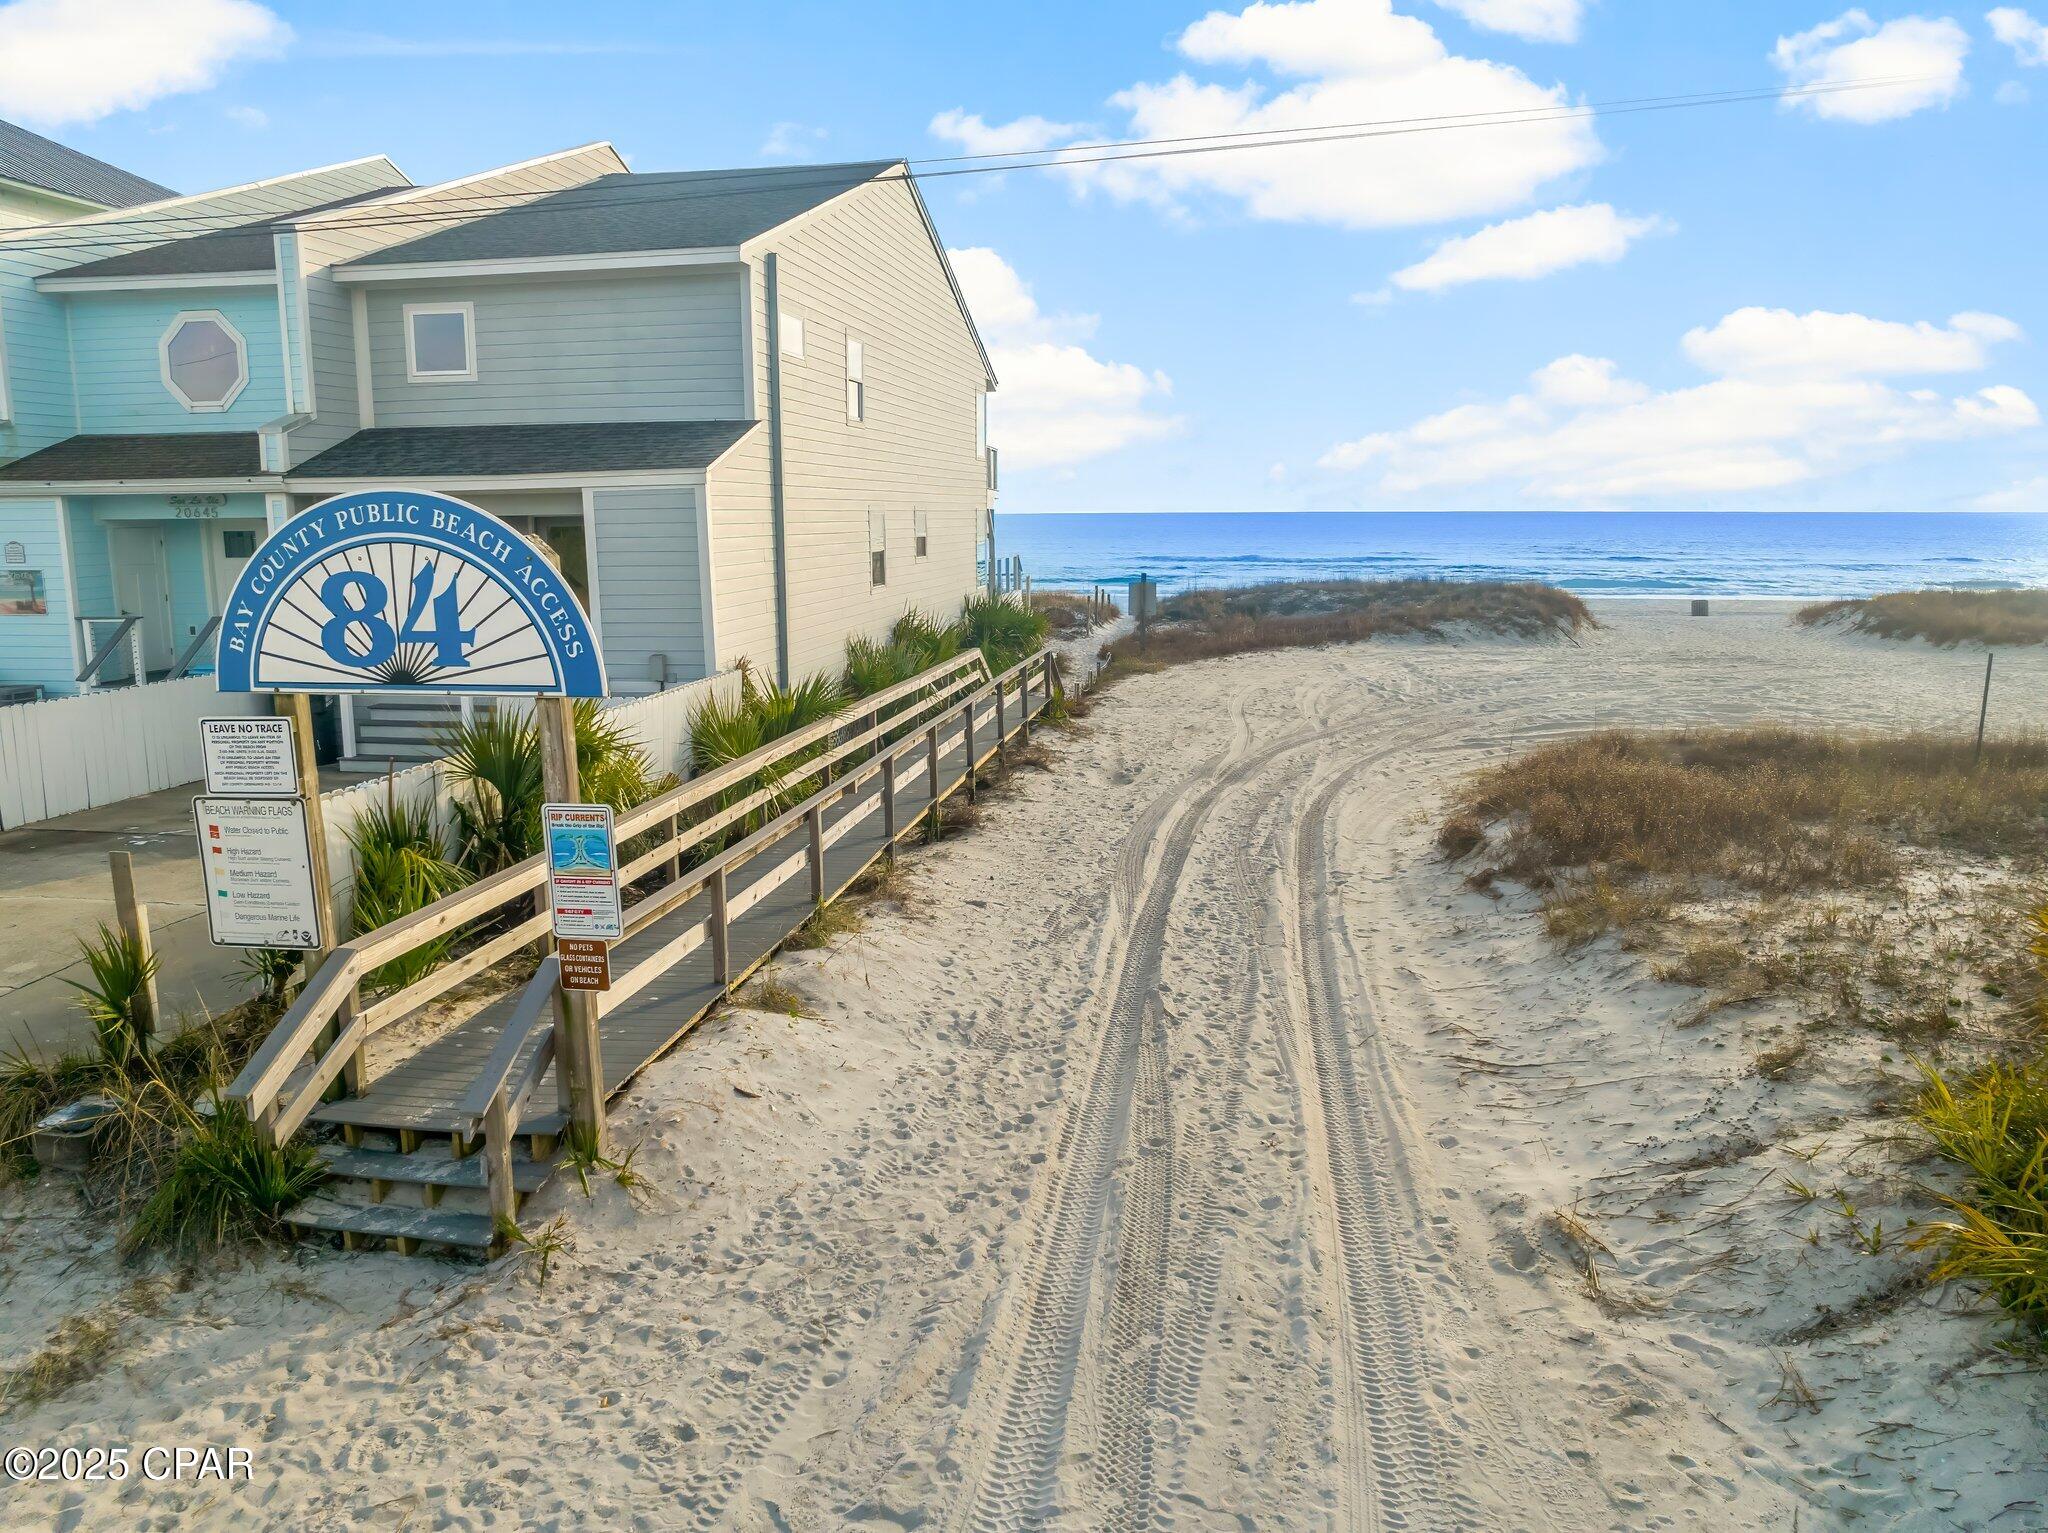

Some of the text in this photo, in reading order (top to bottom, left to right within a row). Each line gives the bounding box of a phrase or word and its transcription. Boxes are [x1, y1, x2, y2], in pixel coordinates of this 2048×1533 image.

[176, 508, 218, 518] 20645
[229, 503, 584, 659] BAY COUNTY PUBLIC BEACH ACCESS
[320, 560, 476, 668] 84
[209, 724, 282, 733] LEAVE NO TRACE
[205, 806, 292, 816] BEACH WARNING FLAGS
[235, 913, 266, 922] Dangerous
[575, 965, 602, 974] VEHICLES
